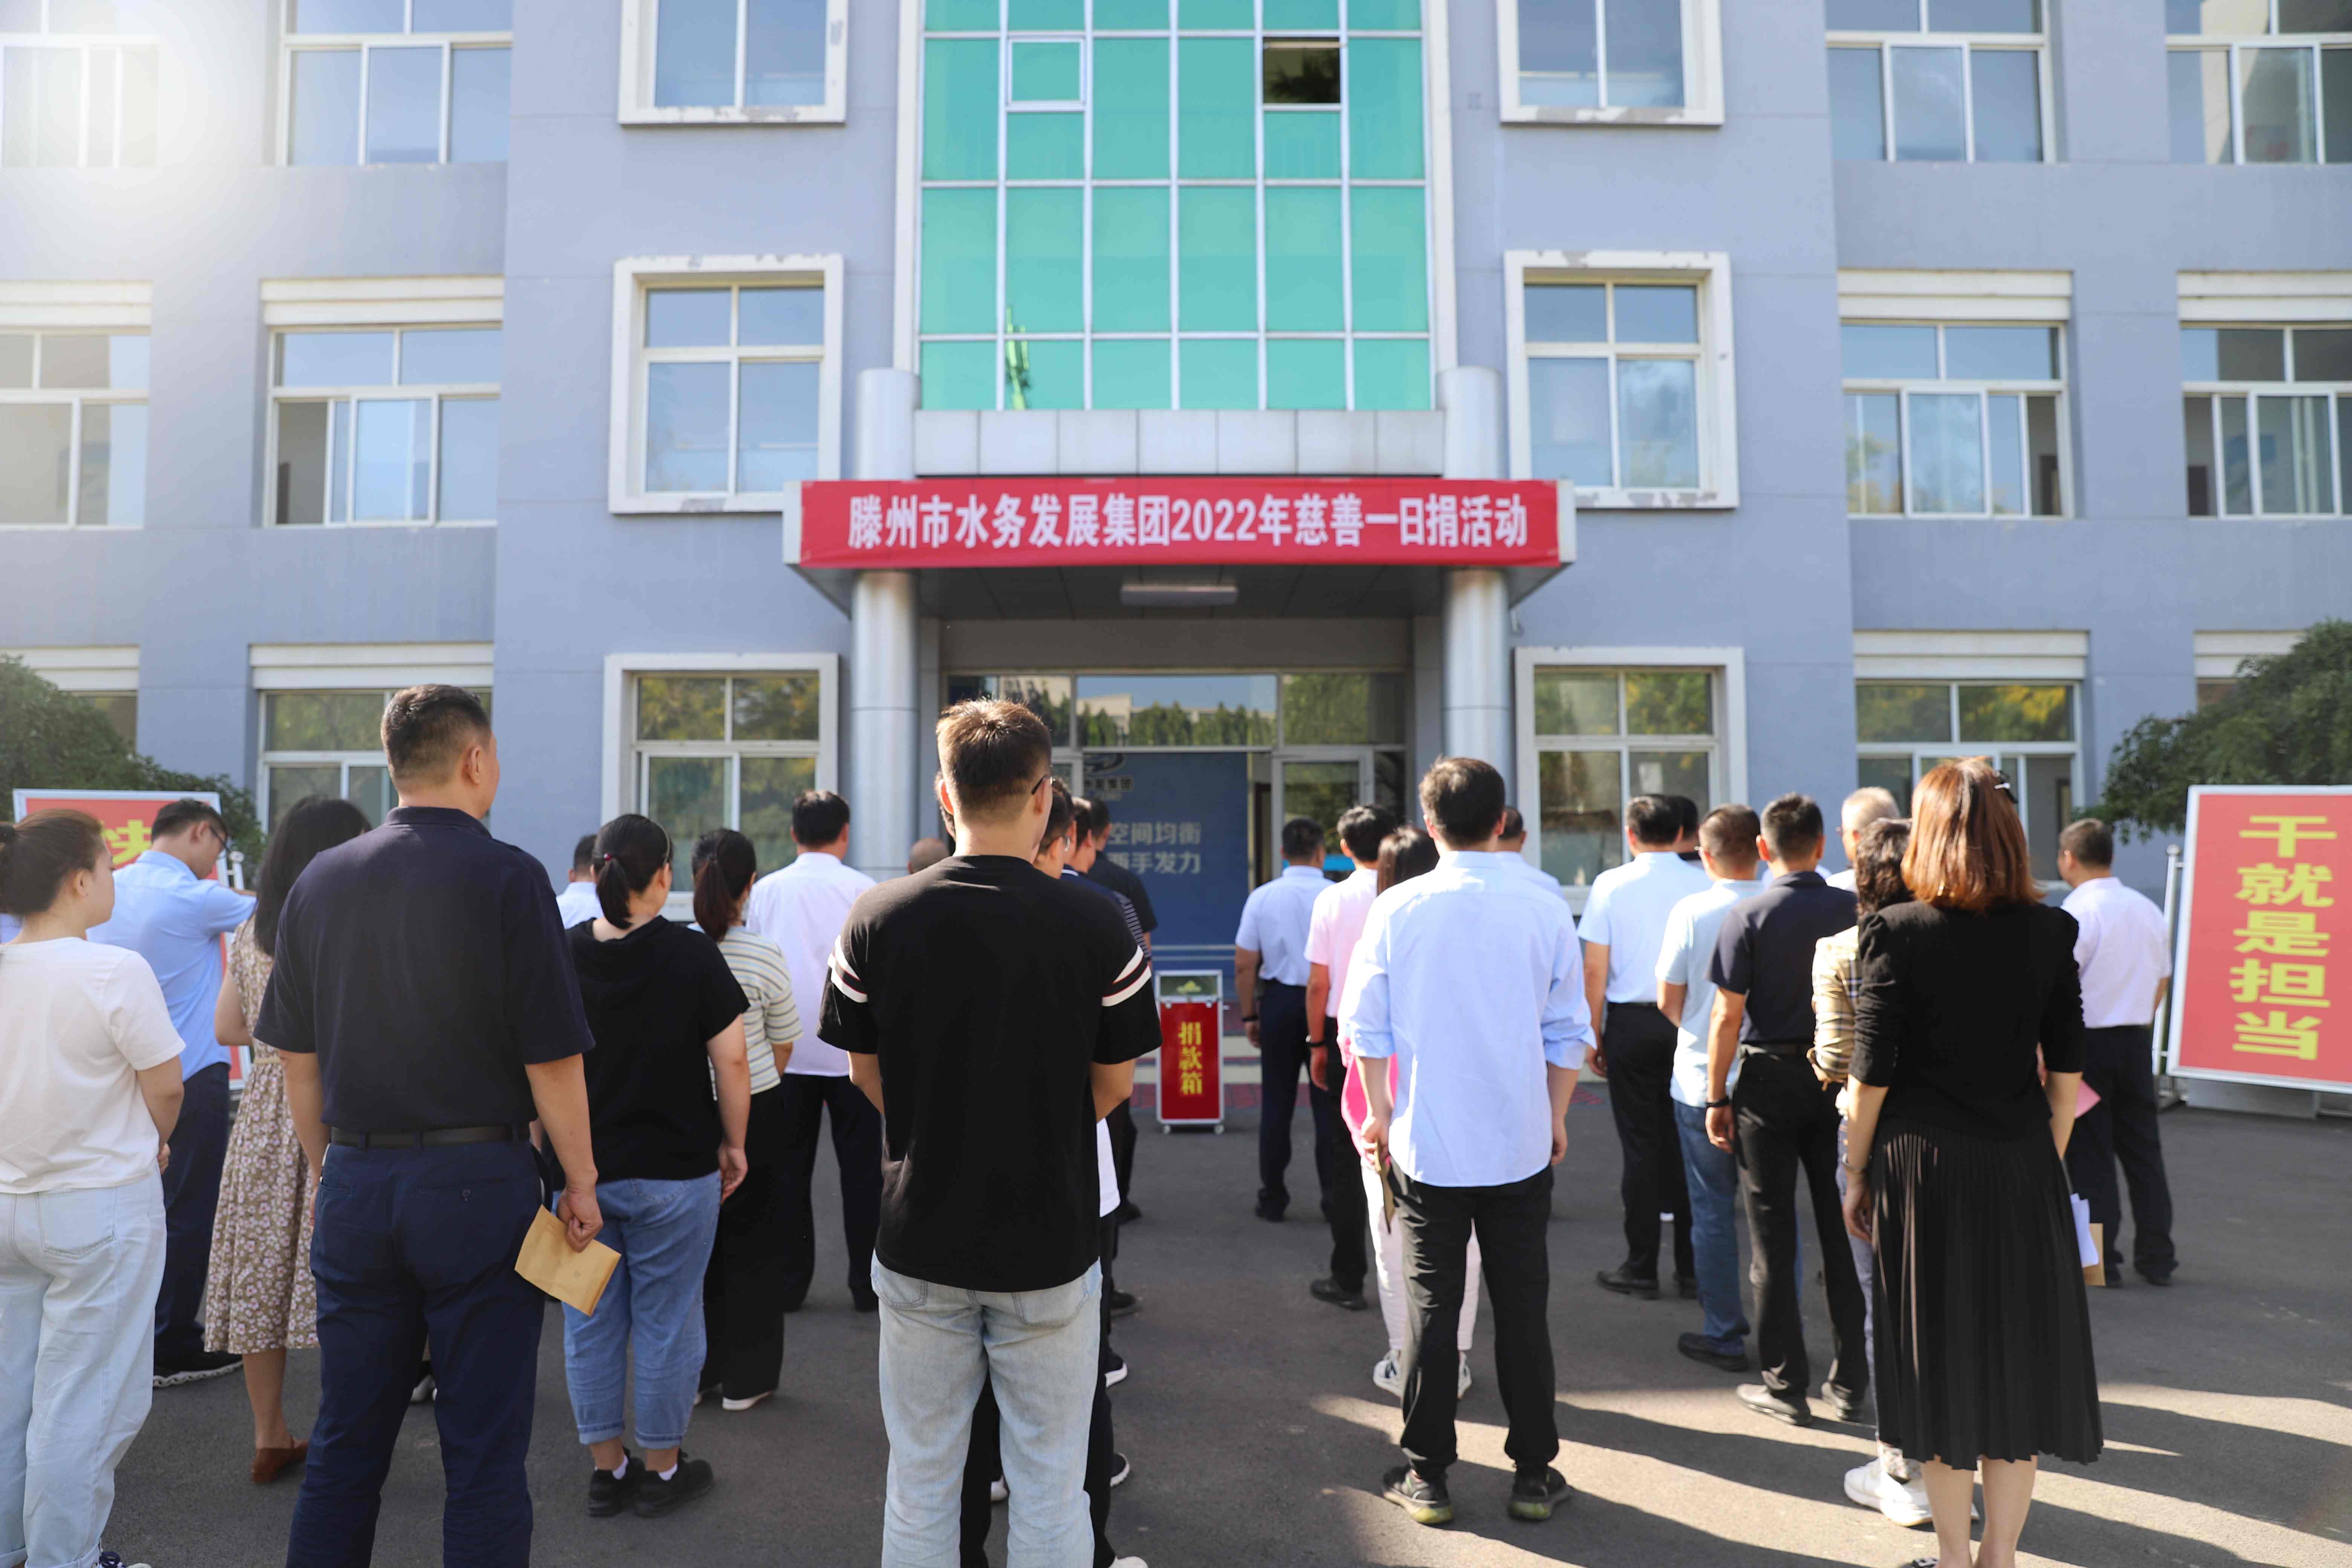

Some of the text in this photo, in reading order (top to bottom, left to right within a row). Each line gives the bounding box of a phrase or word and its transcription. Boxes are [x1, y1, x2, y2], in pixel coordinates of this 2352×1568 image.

[848, 493, 1528, 549] 滕州市水务发展集团2022年慈善一日捐活动
[1107, 822, 1201, 845] 空间均衡
[2229, 815, 2337, 1061] 干就是担当
[1178, 1021, 1202, 1095] 捐款箱
